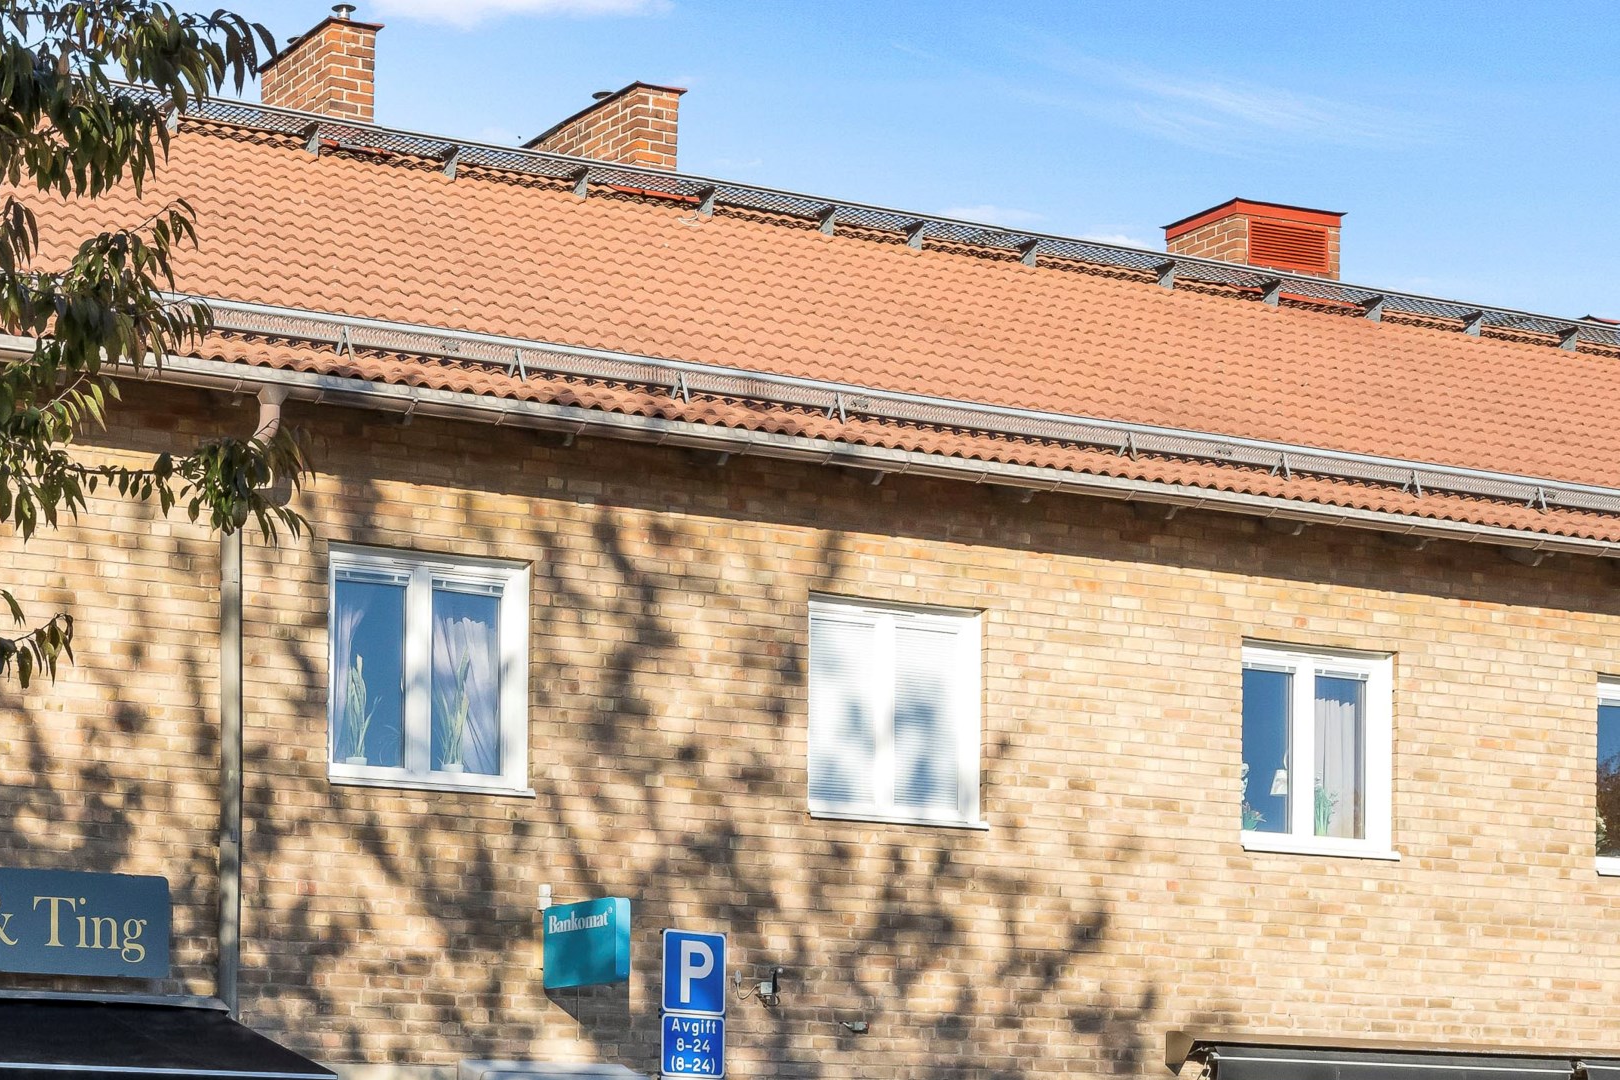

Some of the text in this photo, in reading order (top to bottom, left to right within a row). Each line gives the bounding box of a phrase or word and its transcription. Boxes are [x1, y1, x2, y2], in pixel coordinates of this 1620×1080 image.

[33, 895, 148, 964] Ting
[680, 939, 714, 1003] P
[671, 1018, 716, 1036] Avgift
[676, 1037, 711, 1053] 8-24
[671, 1055, 716, 1074] (8-24)
